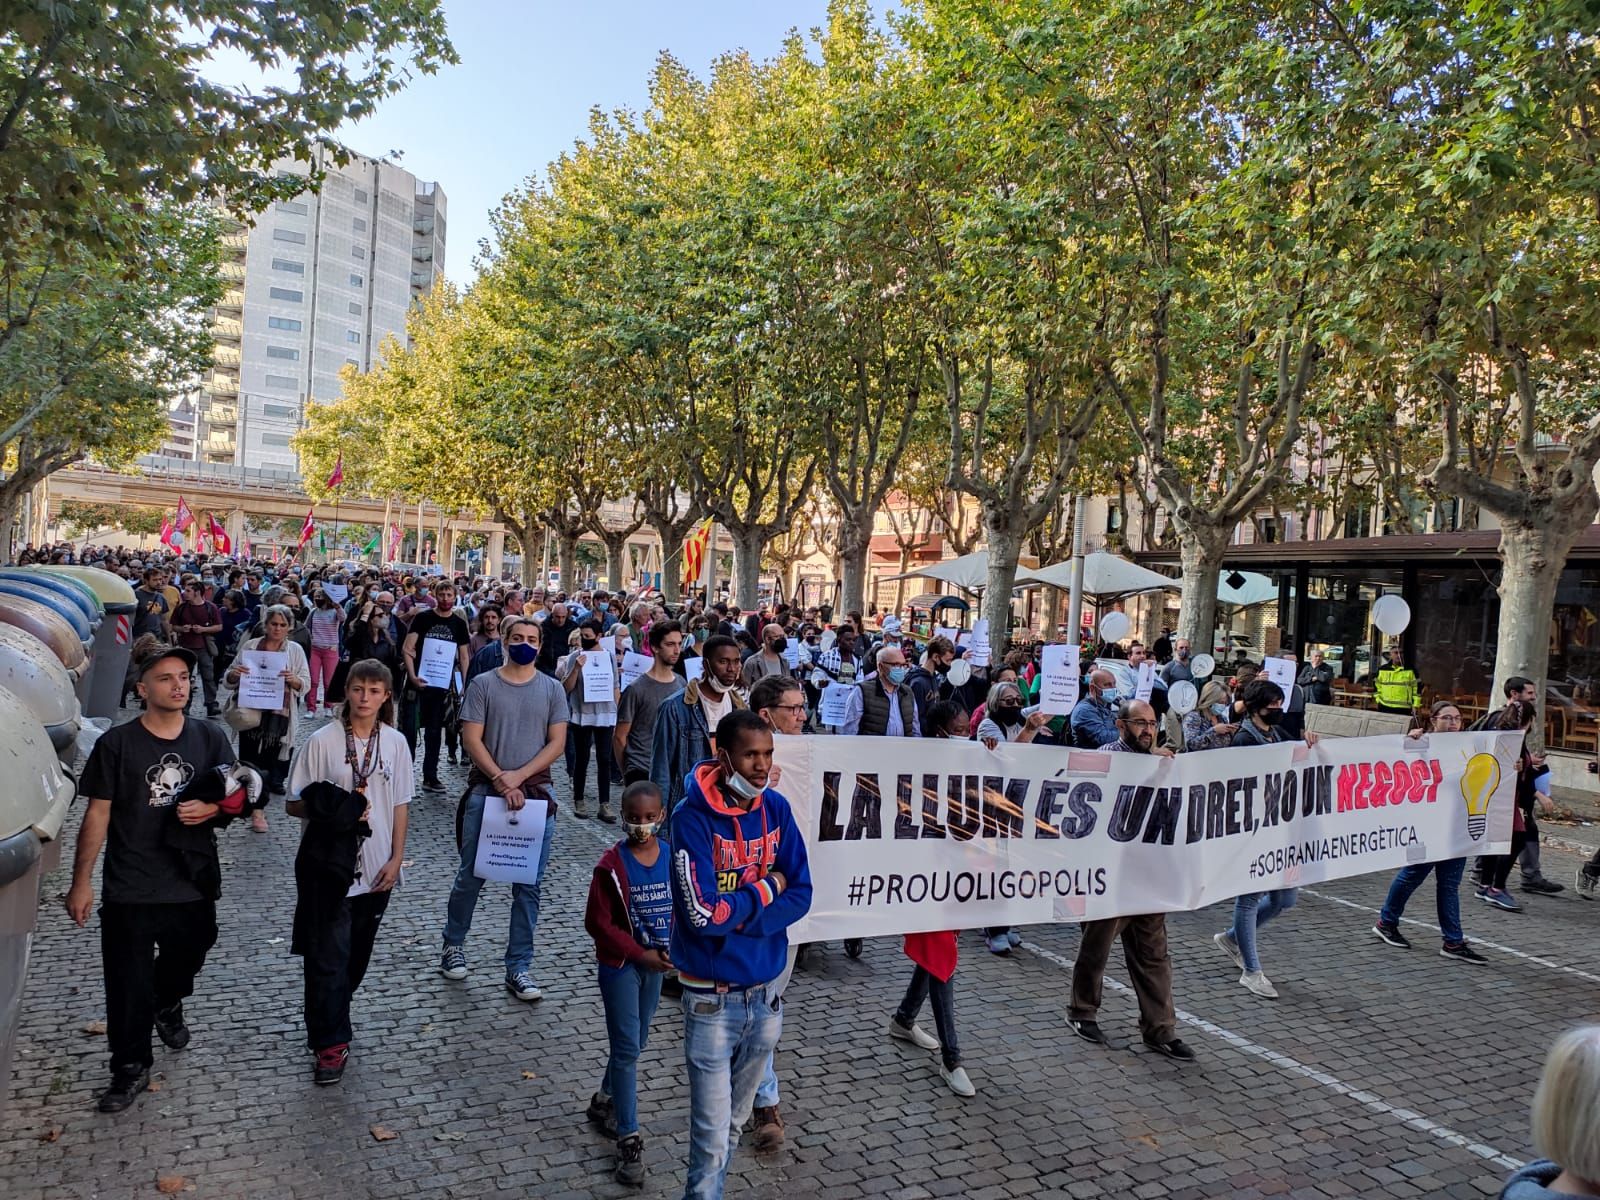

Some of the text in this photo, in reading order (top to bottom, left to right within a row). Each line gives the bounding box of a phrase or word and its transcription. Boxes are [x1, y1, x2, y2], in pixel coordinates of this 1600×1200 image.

[818, 759, 1443, 846] LA LLUM ÉS UN DRET, NO UN NEGOCI
[1249, 825, 1419, 879] #SOBIRANIAENERGÈTICA
[717, 872, 738, 892] 20
[848, 867, 1107, 906] #PROUOLIGOPOLIS
